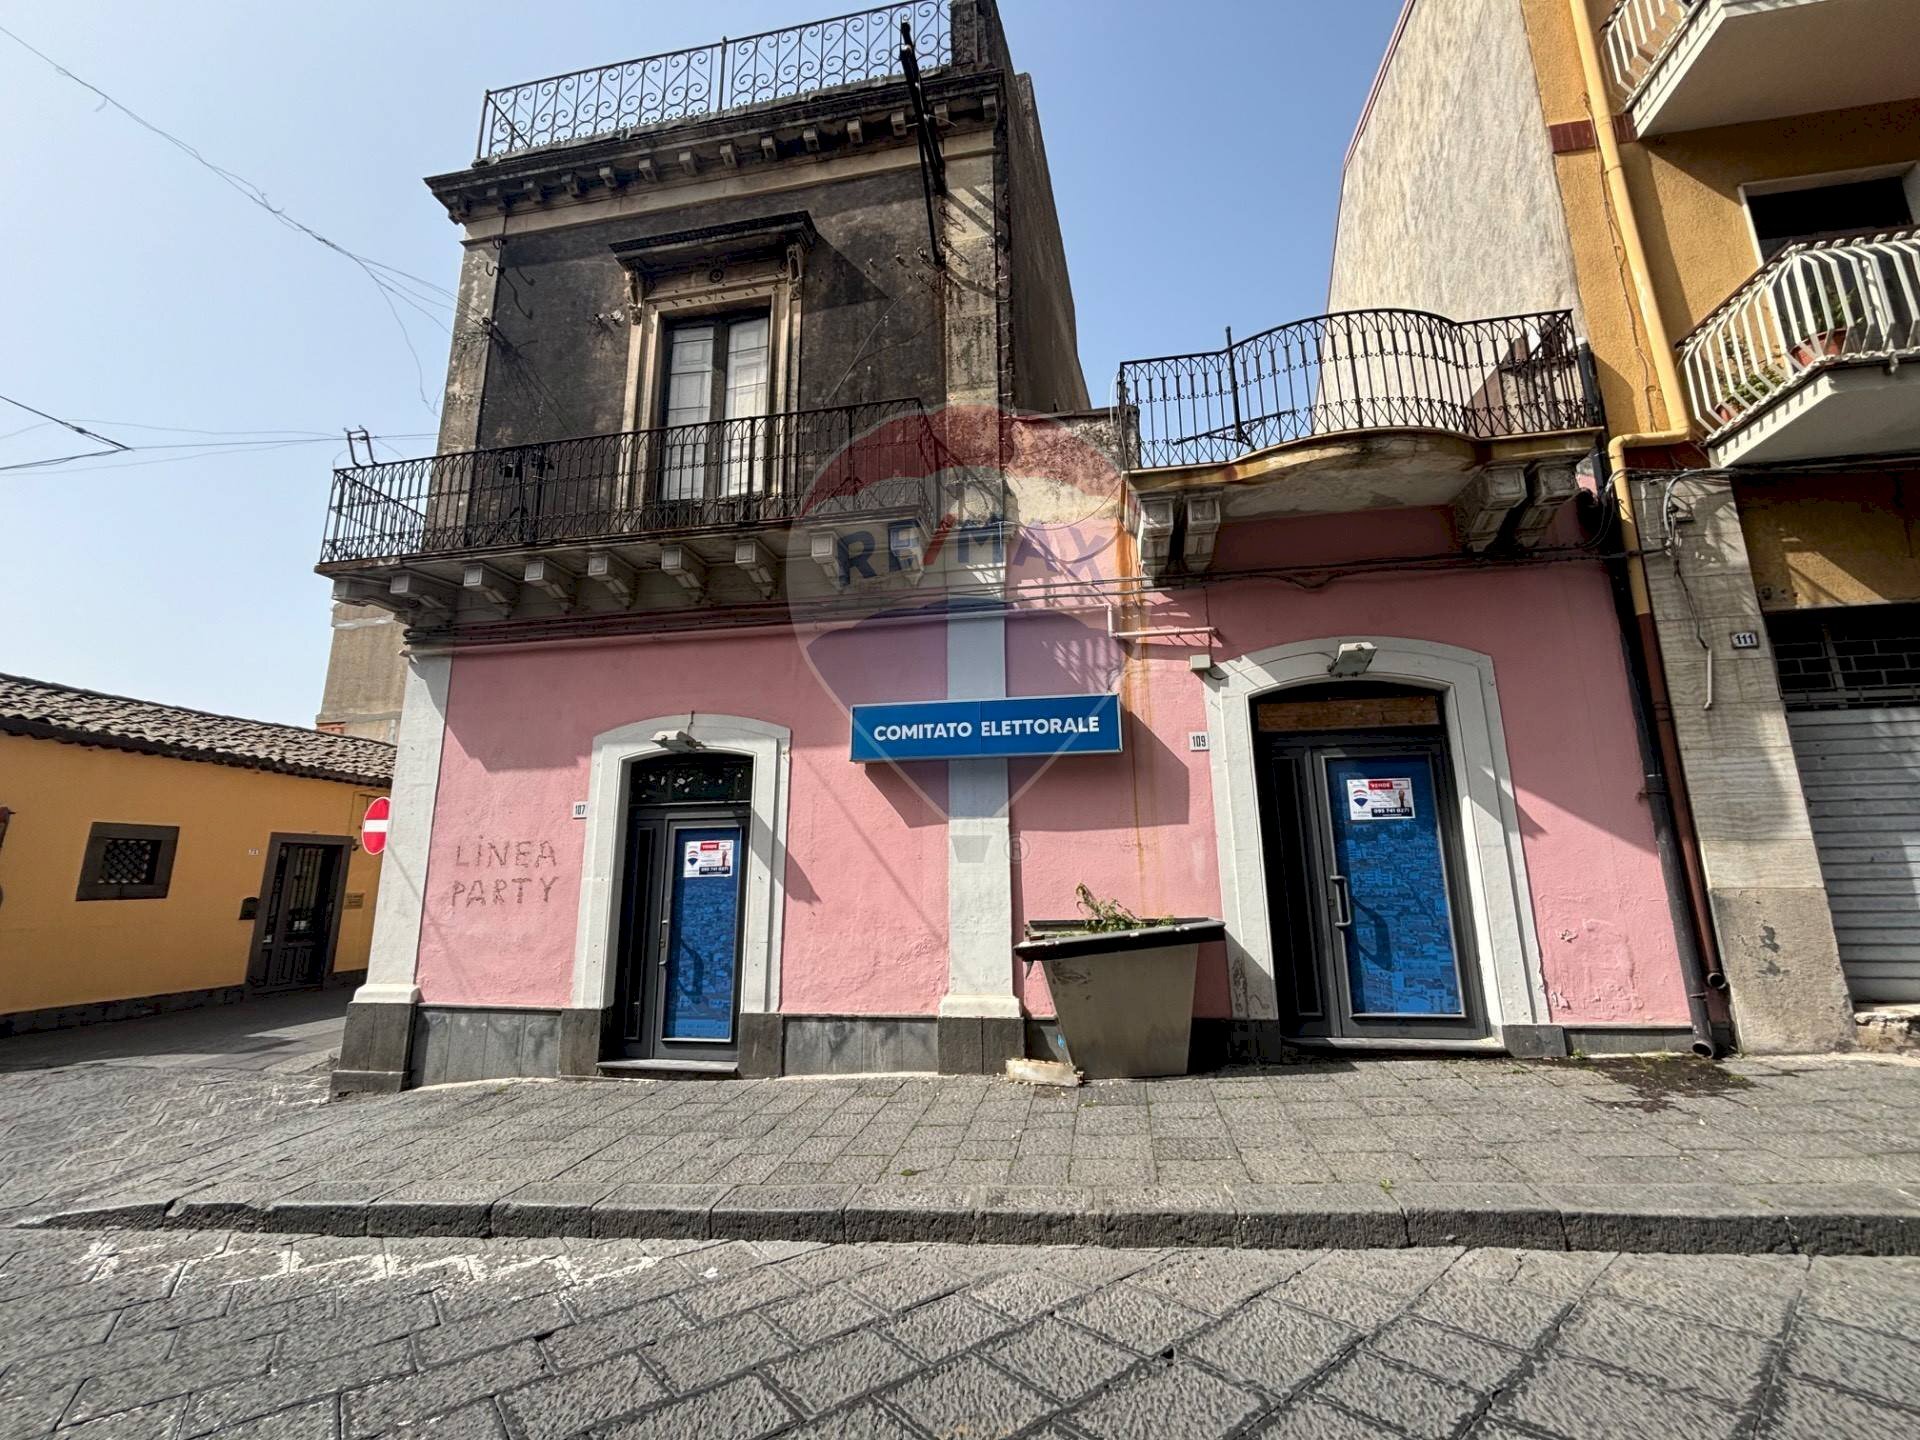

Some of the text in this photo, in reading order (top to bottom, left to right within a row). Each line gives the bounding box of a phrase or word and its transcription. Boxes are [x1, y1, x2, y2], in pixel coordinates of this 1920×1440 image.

[1735, 634, 1754, 645] 111
[873, 716, 1100, 741] COMITATO ELETTORALE
[1192, 735, 1206, 747] 109
[575, 804, 586, 815] 107
[451, 876, 559, 908] PARTY
